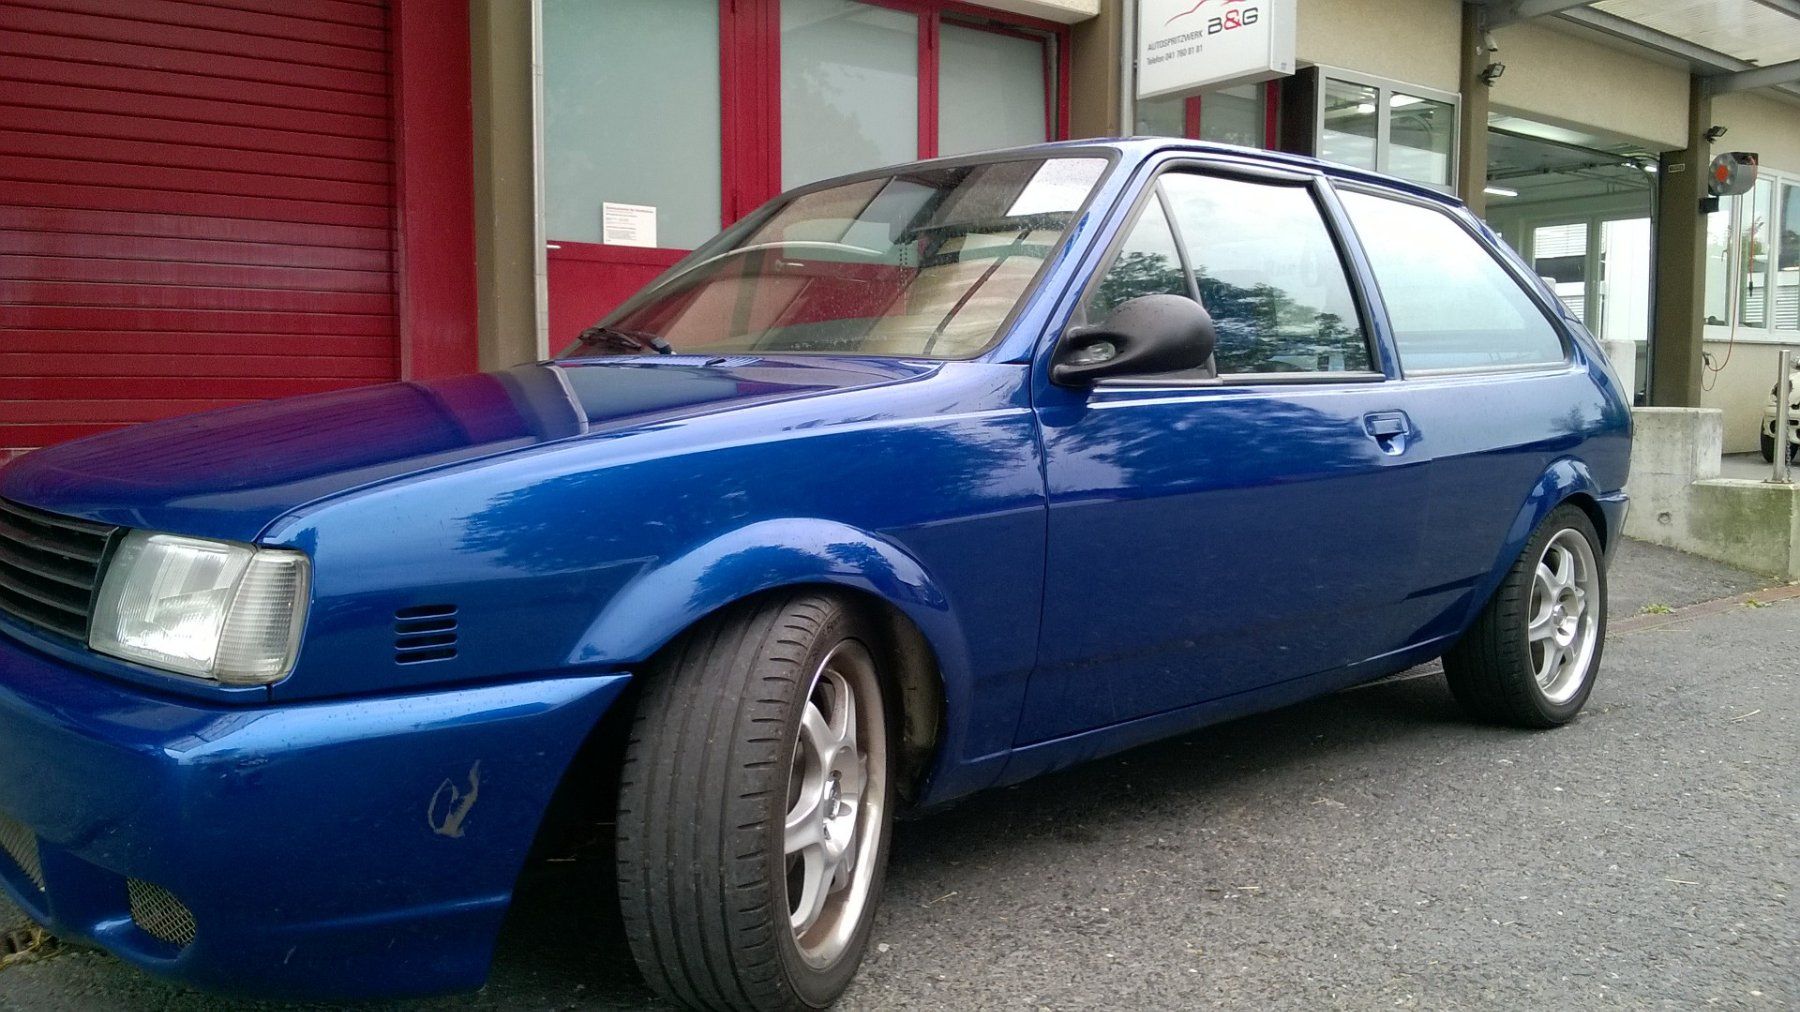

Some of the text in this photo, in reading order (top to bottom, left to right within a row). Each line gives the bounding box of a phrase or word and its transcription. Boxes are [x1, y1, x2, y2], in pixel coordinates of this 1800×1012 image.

[1207, 7, 1259, 35] B&G
[1147, 30, 1203, 51] AUTOSPRITZWERK
[1146, 55, 1165, 65] Telefon
